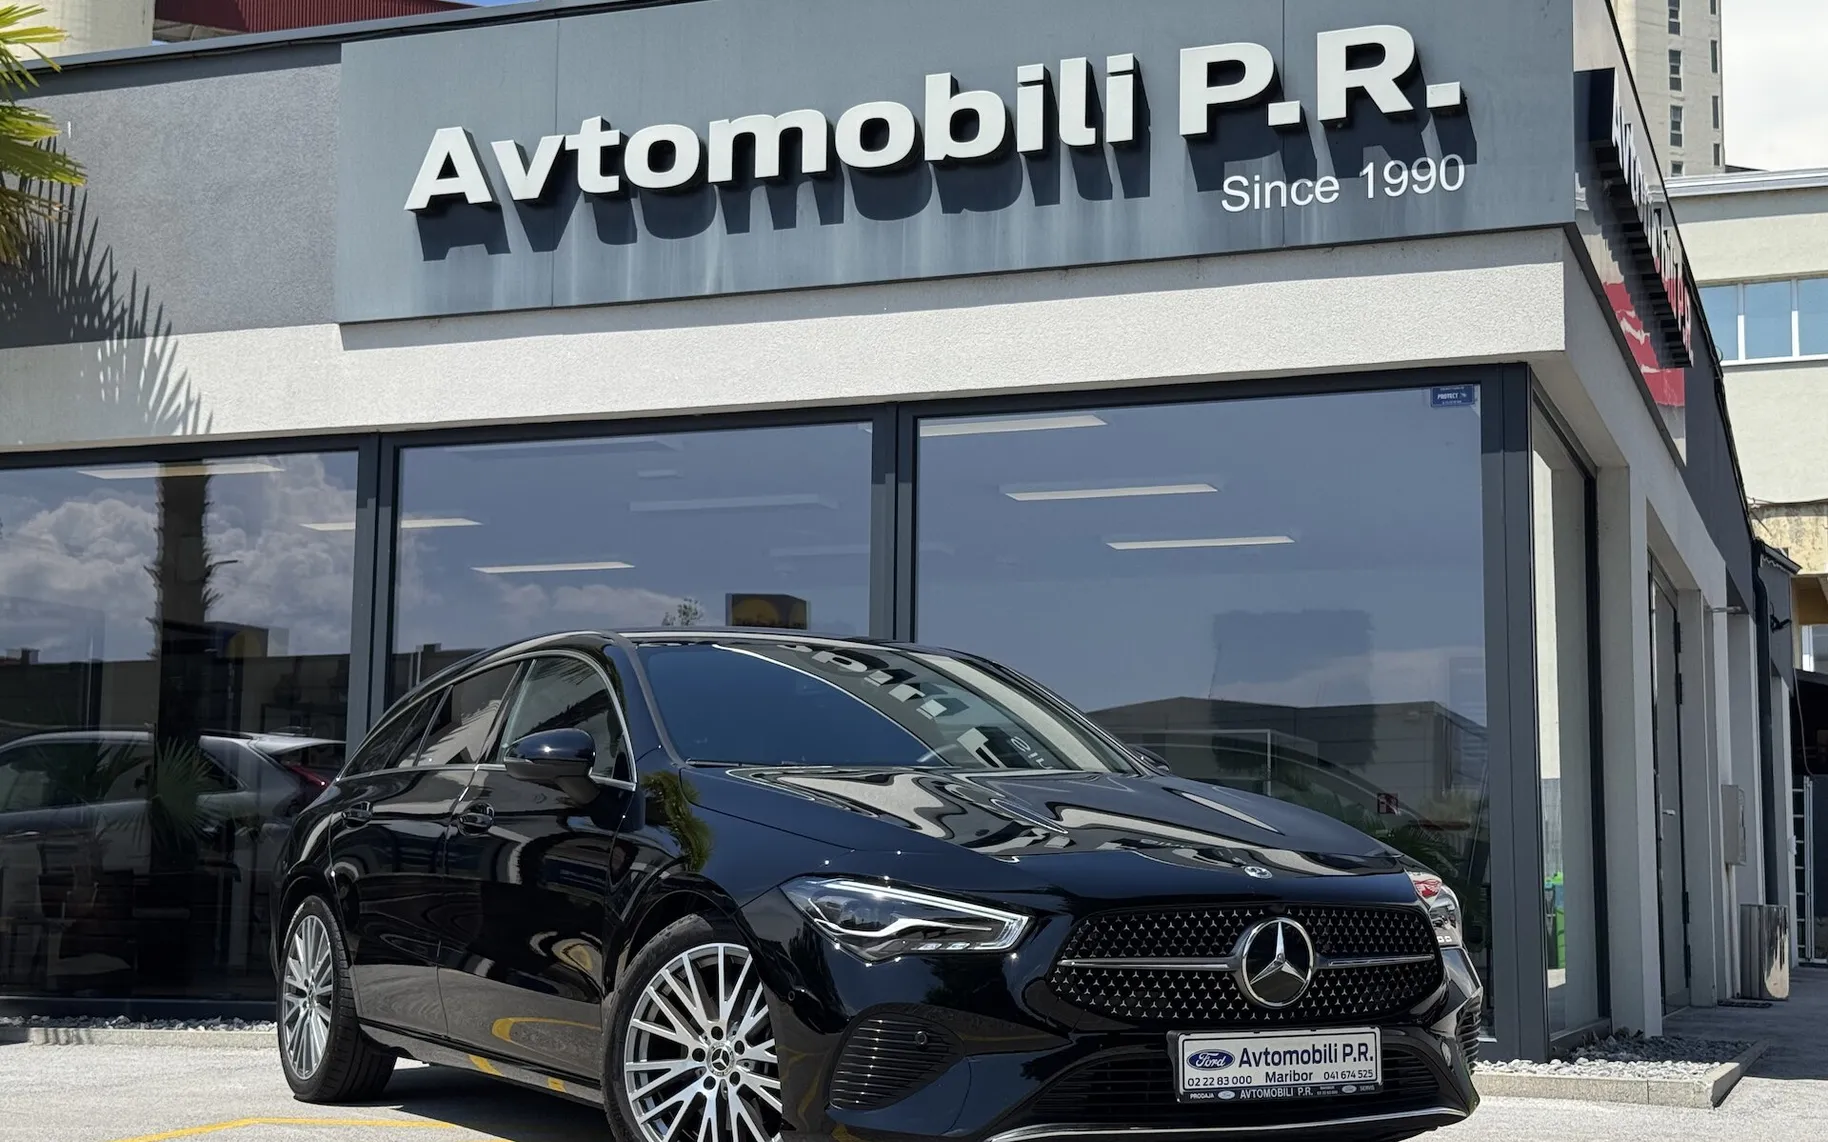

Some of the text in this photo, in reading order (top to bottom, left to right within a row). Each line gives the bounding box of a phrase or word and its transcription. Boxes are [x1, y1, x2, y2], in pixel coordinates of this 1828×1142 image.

[403, 24, 1462, 212] Avtomobili P.R.
[1221, 154, 1466, 213] Since 1990
[1195, 1052, 1227, 1067] Ford
[1238, 1043, 1374, 1068] Avtomobili P.R.
[1187, 1069, 1374, 1087] 02 22 83 000 Maribor 041 674 525
[1240, 1087, 1294, 1099] AVTOMOBILI
[1297, 1086, 1314, 1096] P.R.
